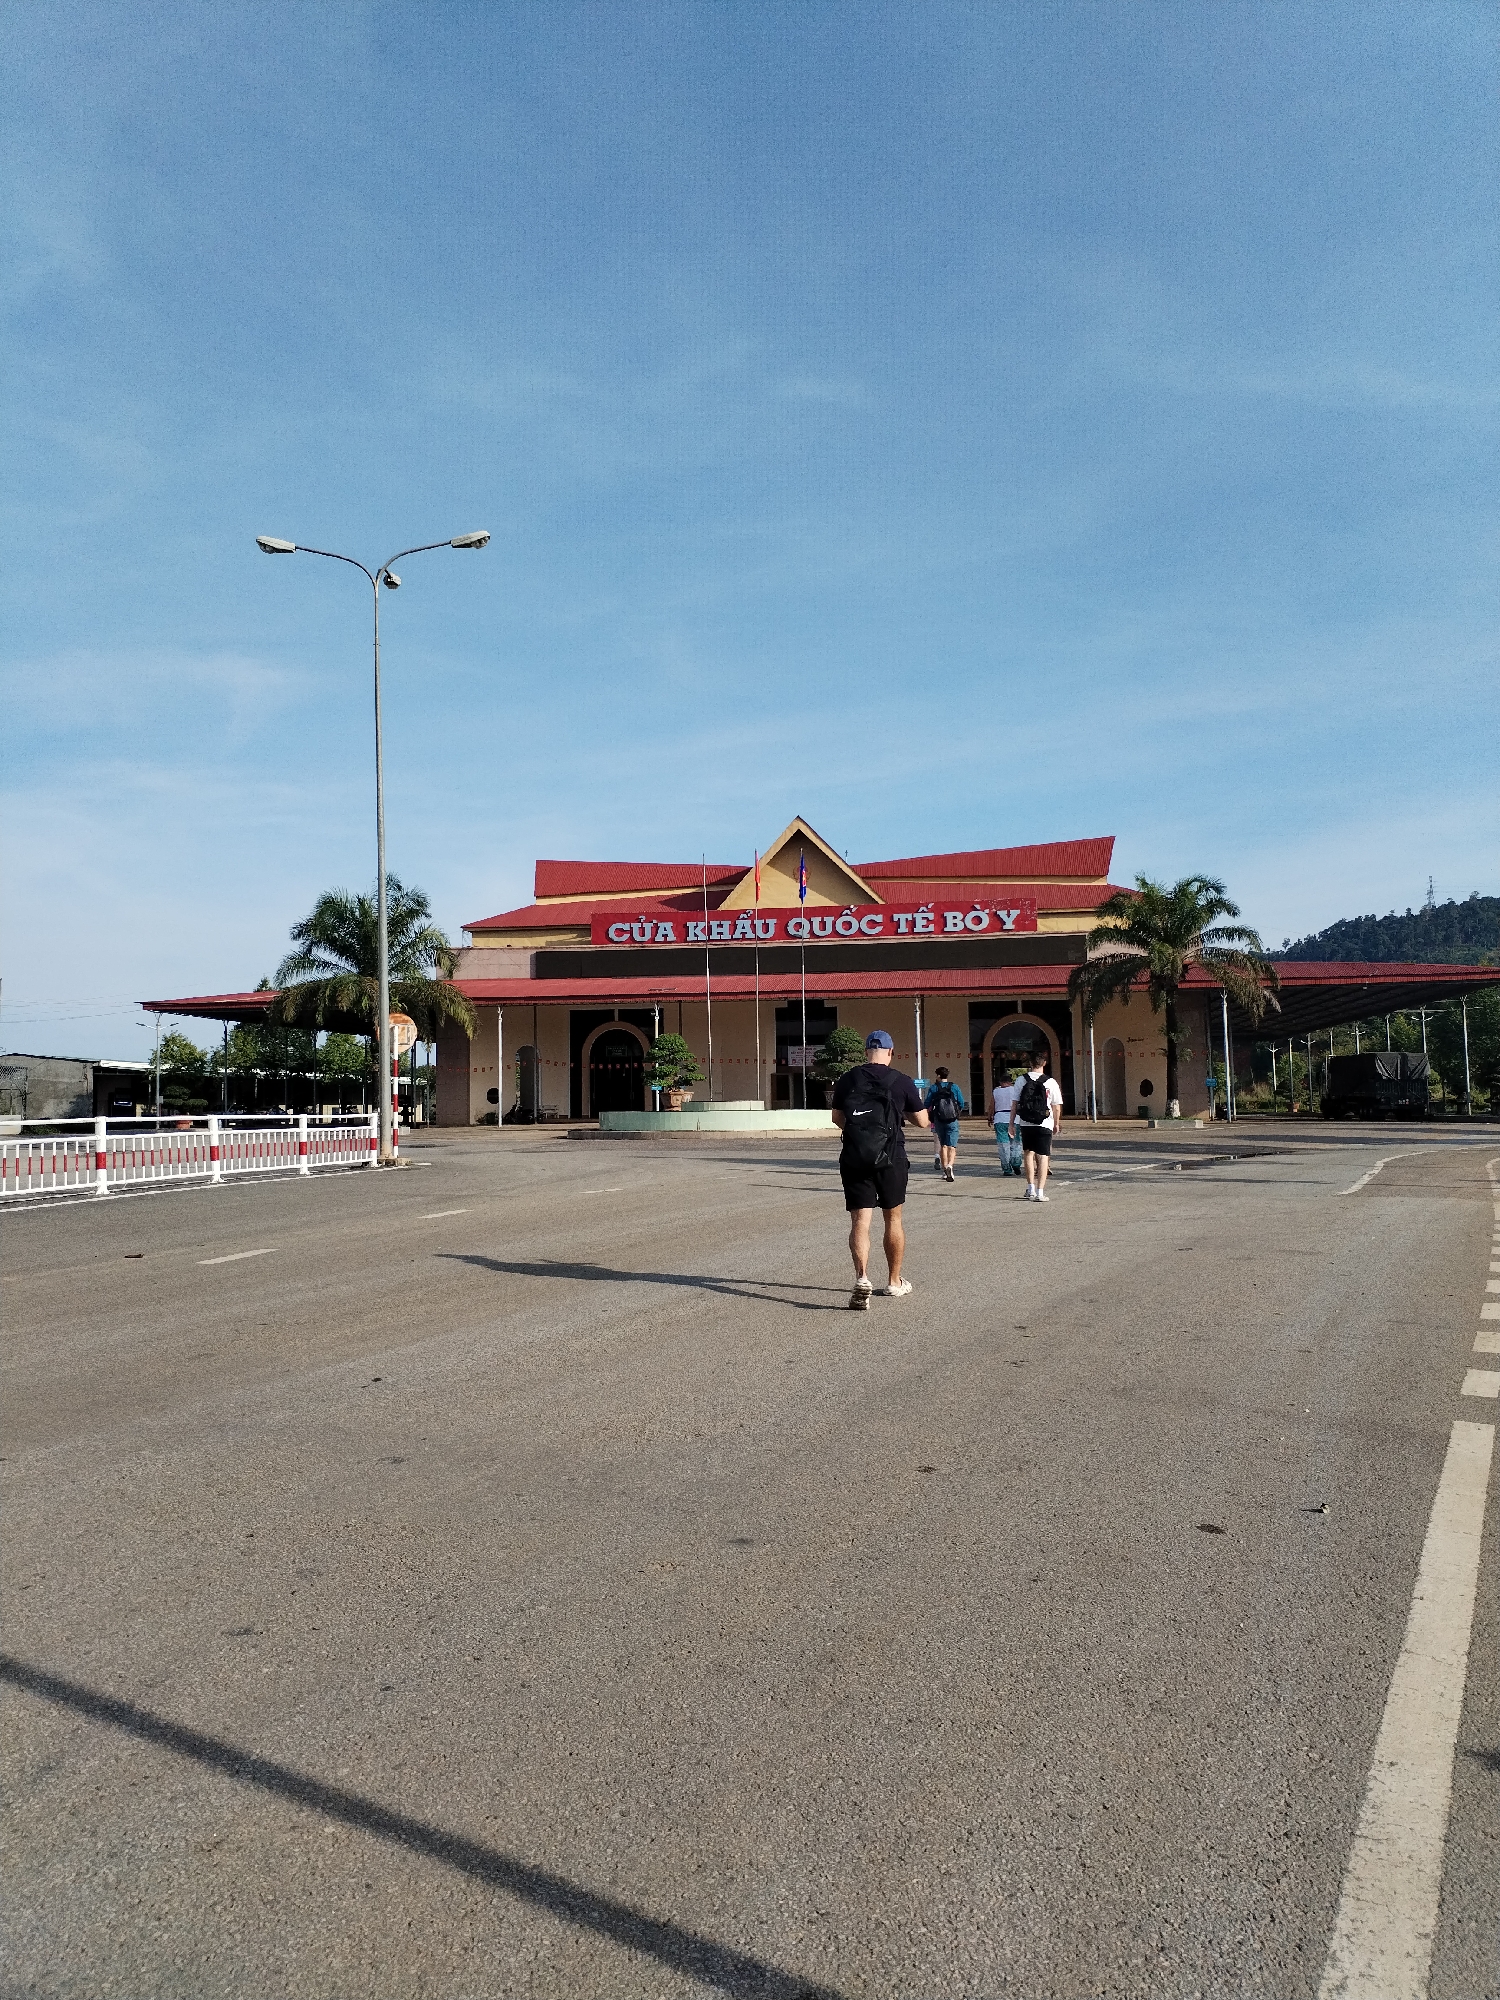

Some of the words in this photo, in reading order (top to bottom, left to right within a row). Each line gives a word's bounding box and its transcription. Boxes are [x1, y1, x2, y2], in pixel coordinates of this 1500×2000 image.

[608, 915, 676, 942] CỬA
[686, 909, 777, 941] KHẨU
[787, 904, 883, 939] QUỐC
[893, 902, 935, 933] TẾ
[944, 904, 990, 932] BỜ
[996, 909, 1021, 930] Y
